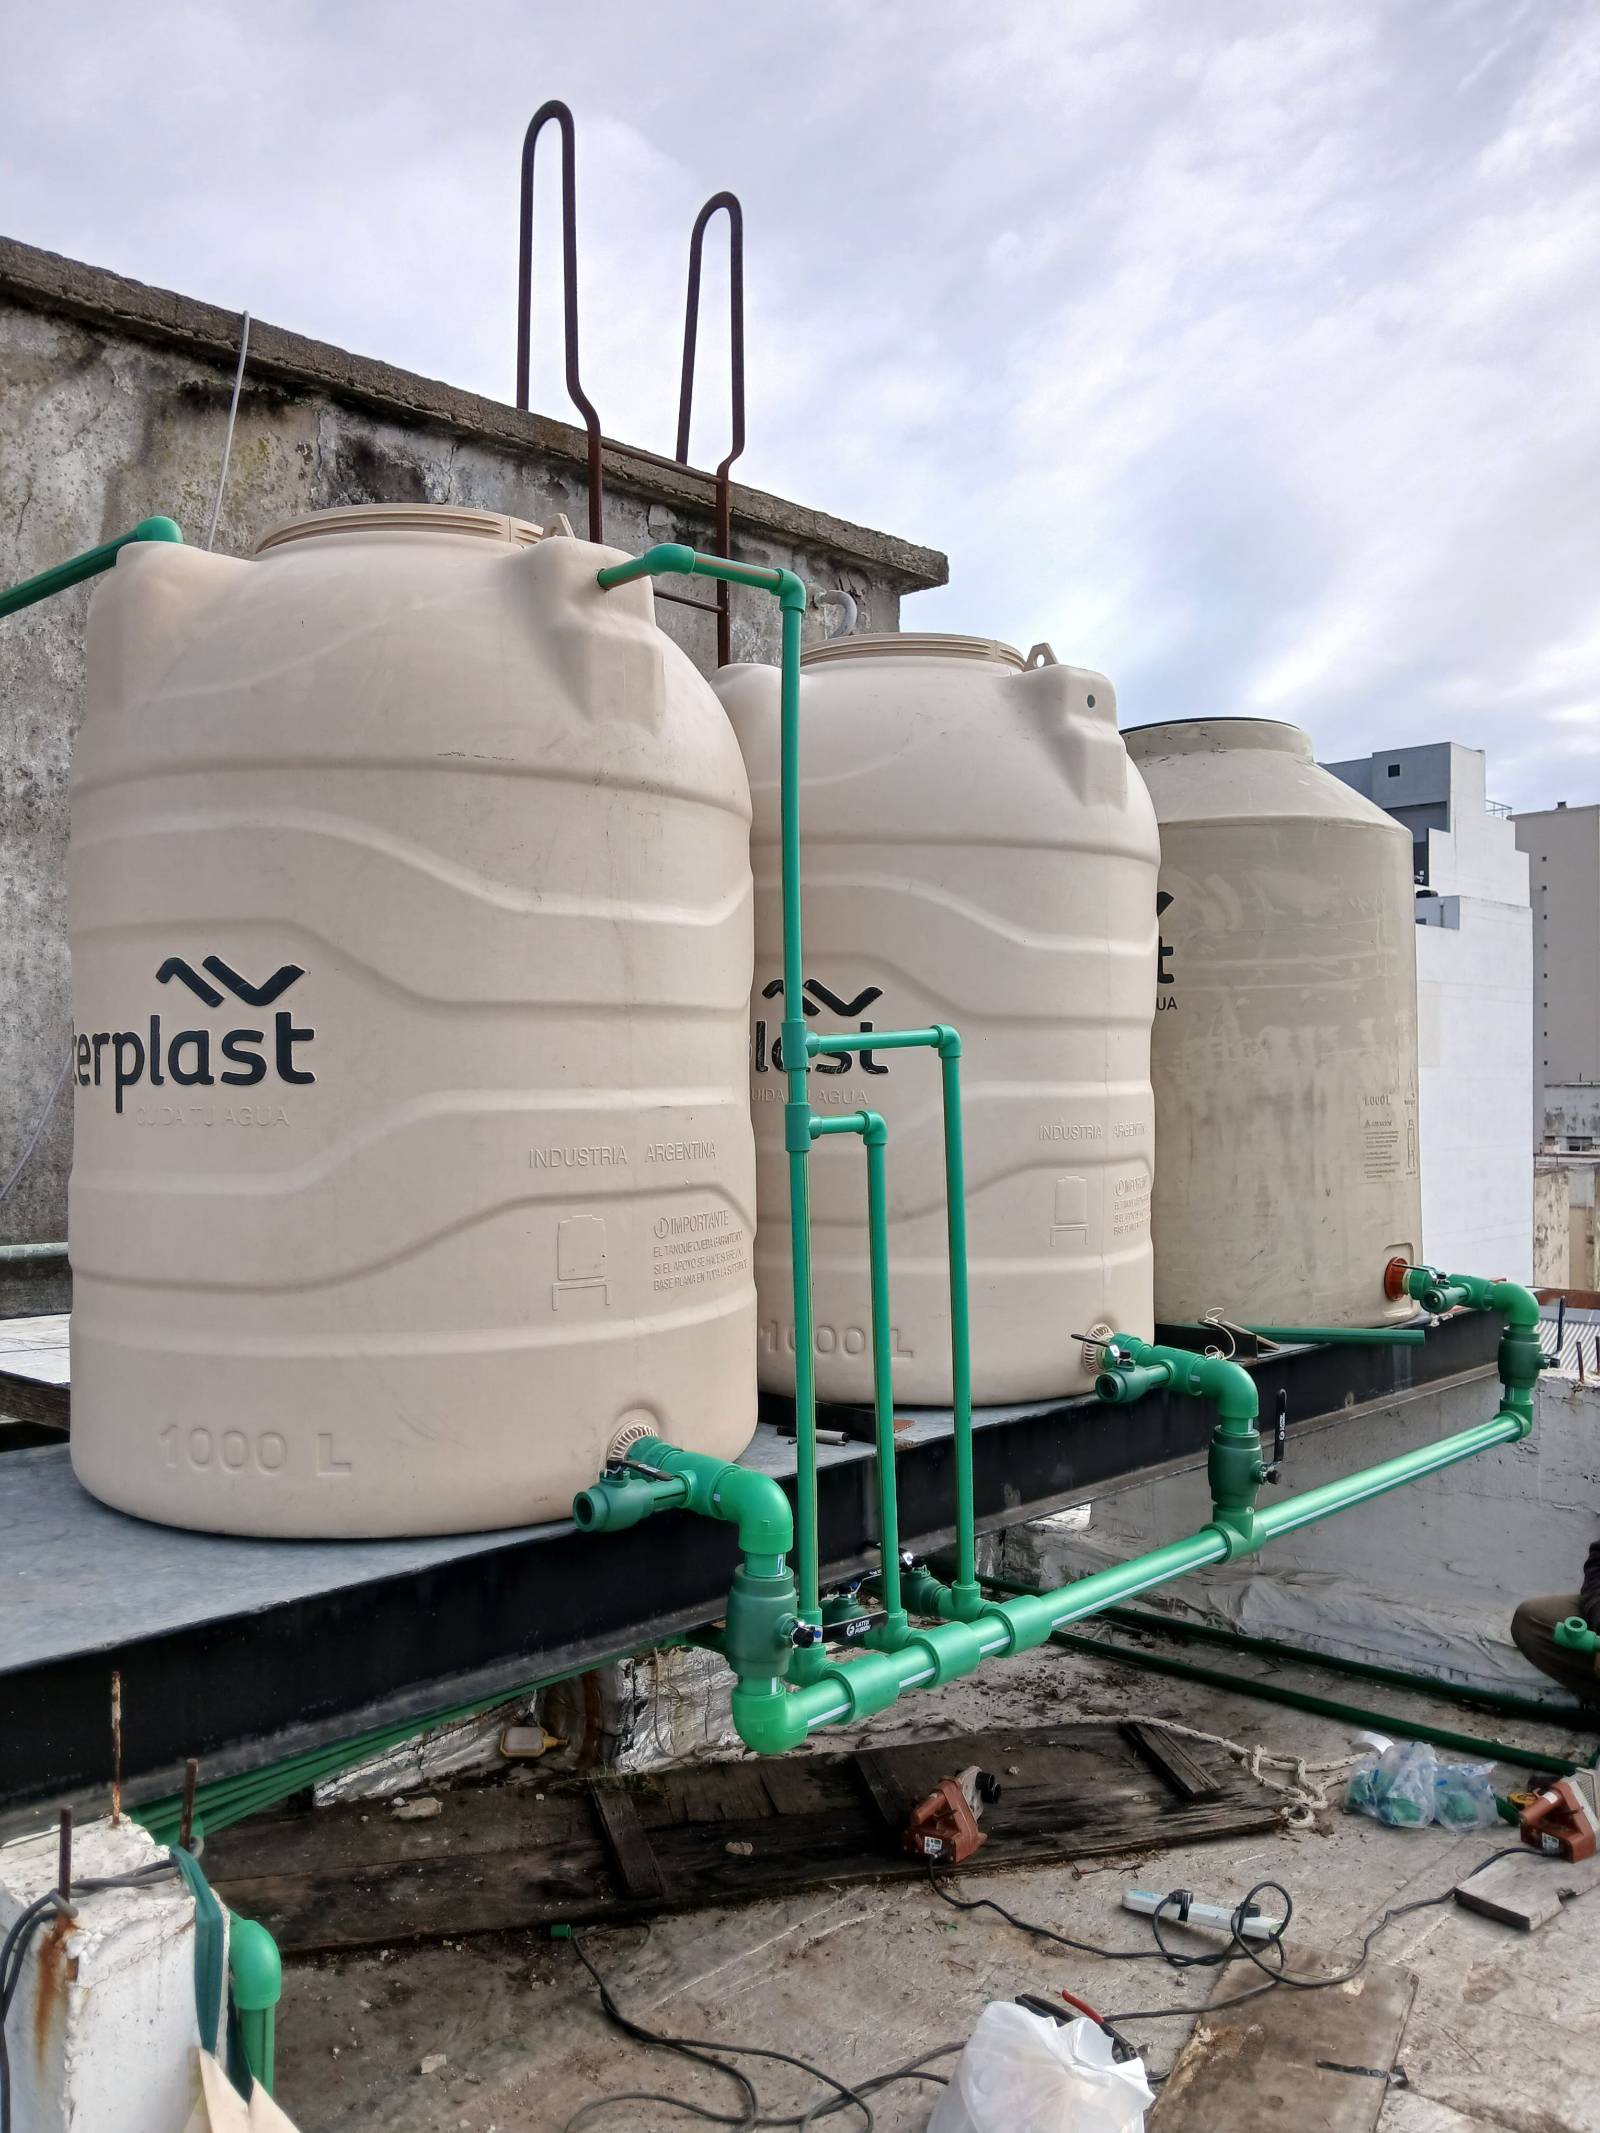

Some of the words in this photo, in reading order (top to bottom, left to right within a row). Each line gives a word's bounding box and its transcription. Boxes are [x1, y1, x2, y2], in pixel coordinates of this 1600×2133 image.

[74, 1012, 316, 1114] erplast
[750, 1088, 786, 1103] UIDA
[817, 1088, 869, 1105] AGUA
[223, 1104, 290, 1127] AGUA
[1039, 1122, 1103, 1141] INDUSTRIA
[529, 1146, 628, 1169] INDUSTRIA
[647, 1140, 716, 1163] ARGENTINA
[671, 1209, 729, 1235] IMPORTANTE
[159, 1424, 287, 1477] 1000
[316, 1432, 352, 1477] L
